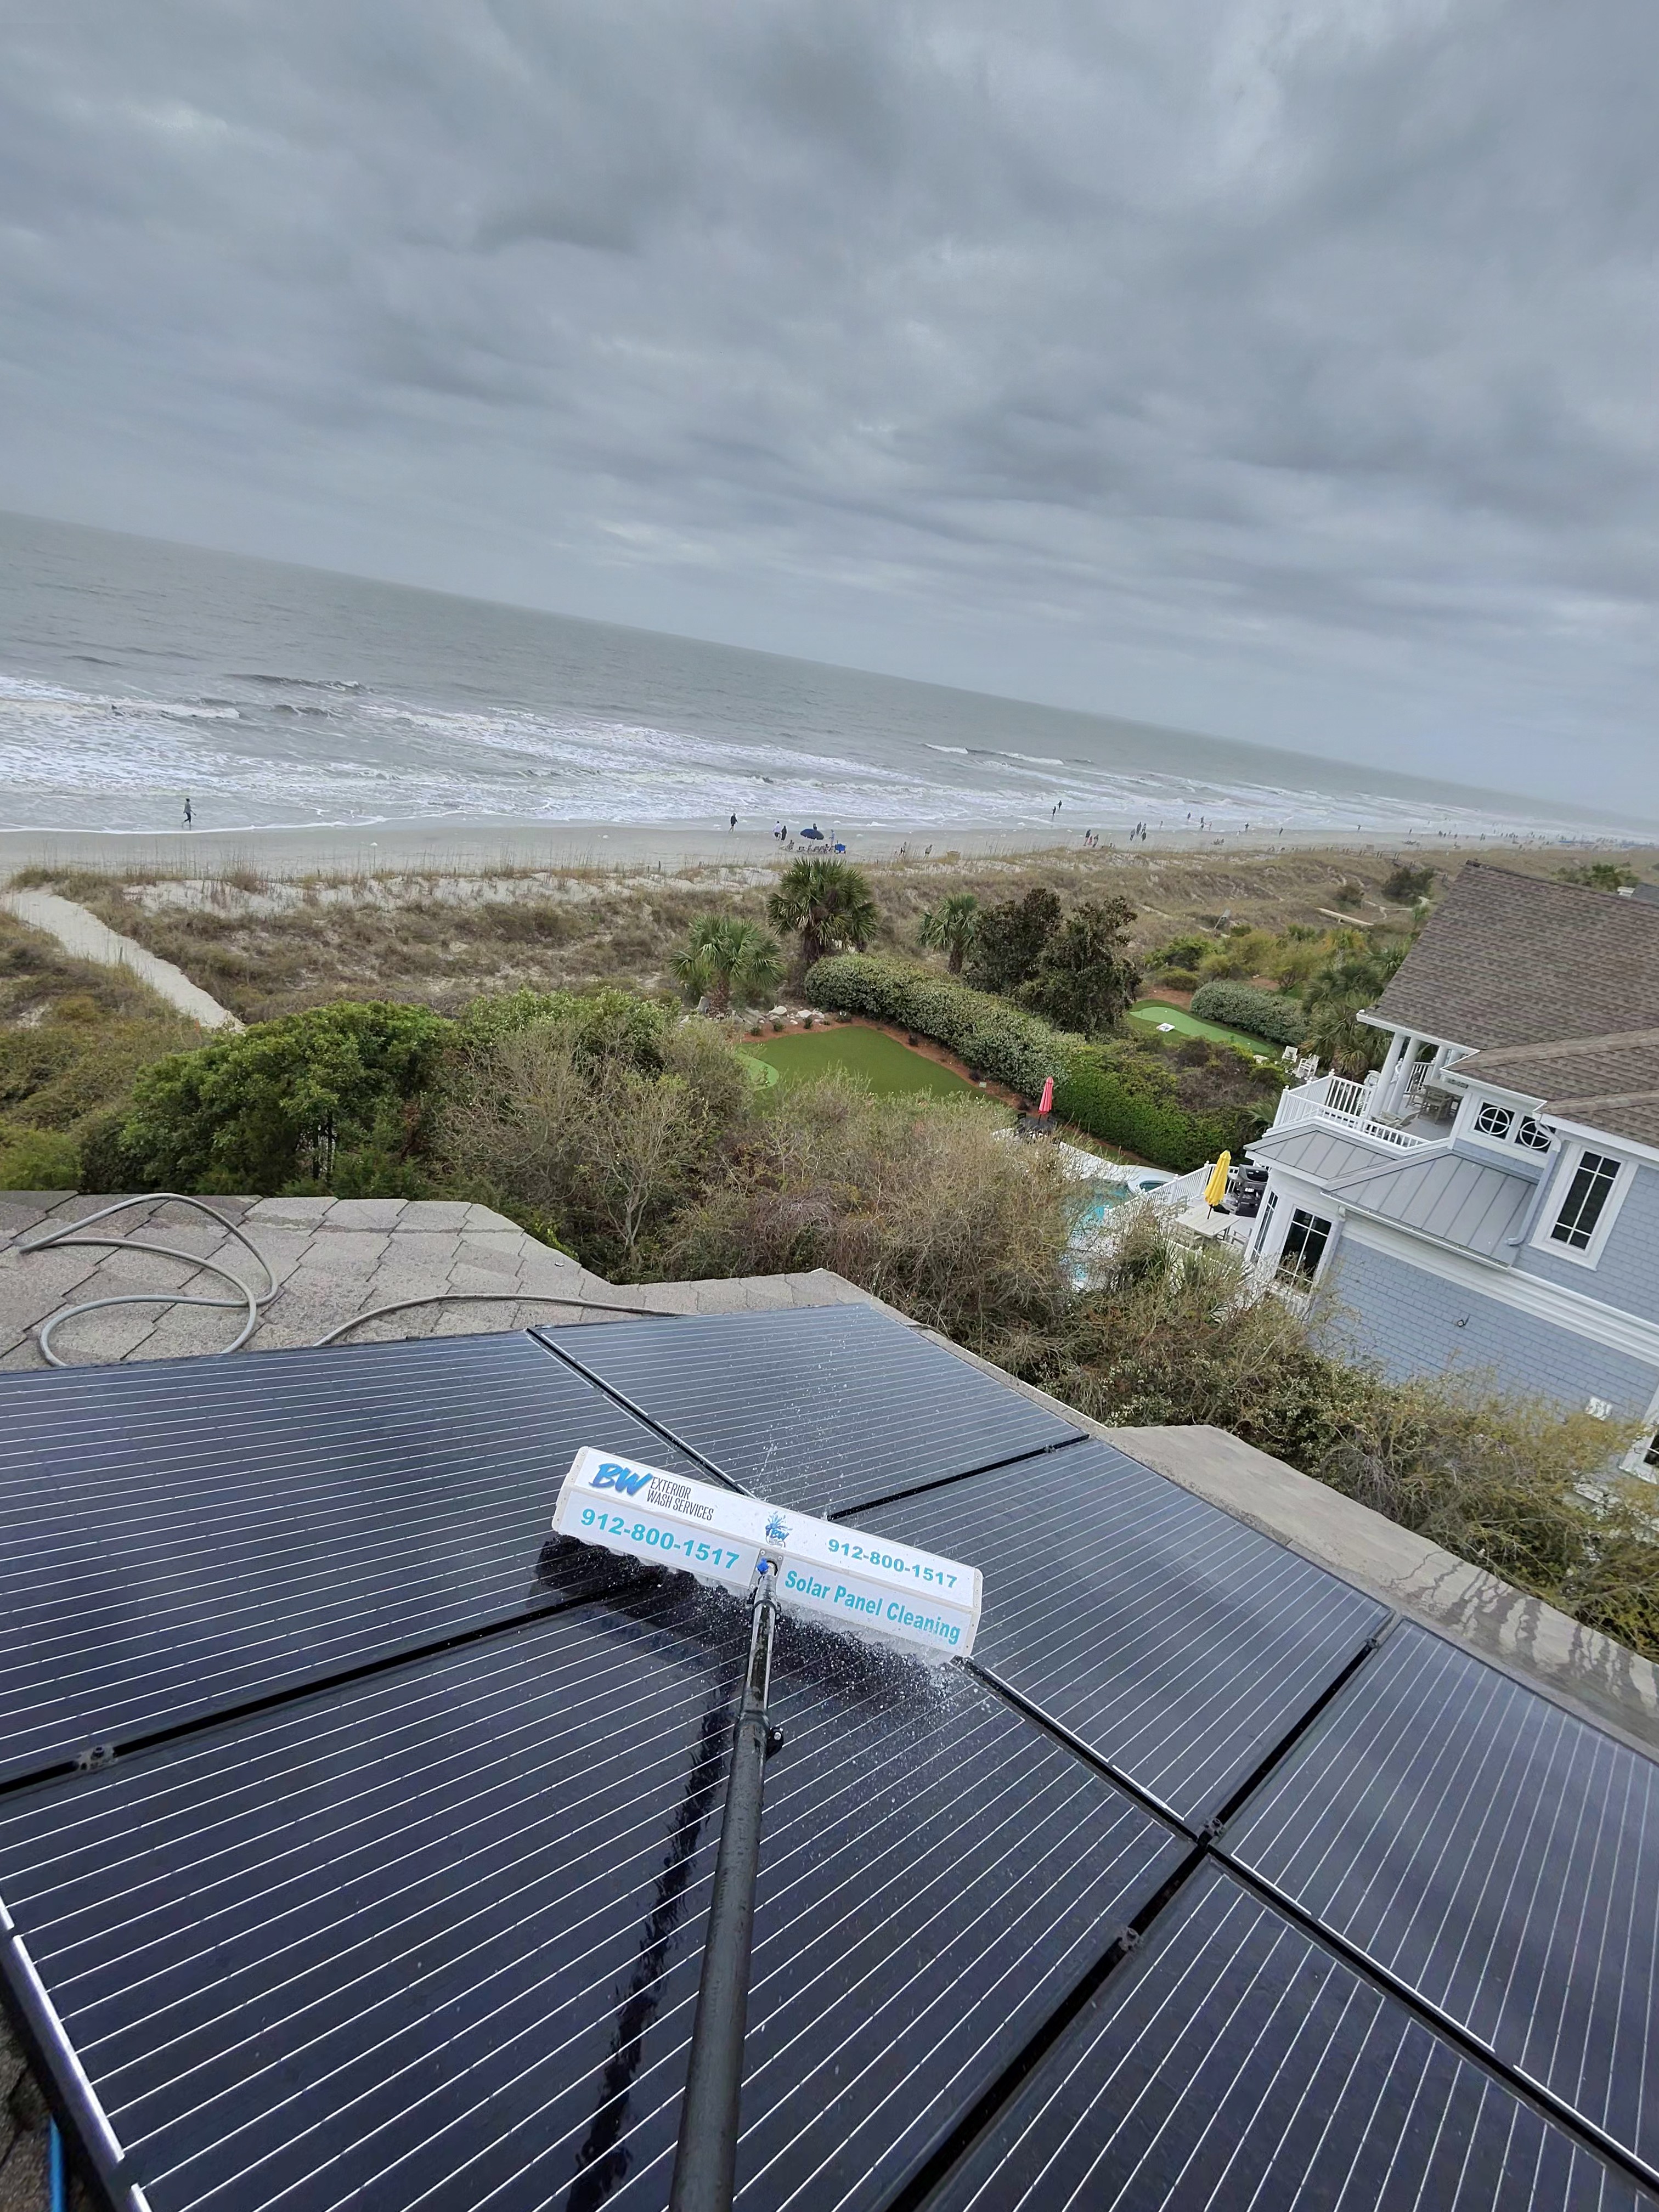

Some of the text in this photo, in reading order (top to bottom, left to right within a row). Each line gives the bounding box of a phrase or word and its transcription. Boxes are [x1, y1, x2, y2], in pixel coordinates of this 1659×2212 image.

[589, 1463, 653, 1497] BW
[650, 1477, 691, 1500] EXTERIOR
[647, 1489, 714, 1521] WASH SERVICES
[581, 1508, 740, 1569] 912-800-1517
[828, 1539, 957, 1588] 912-800-1517
[785, 1570, 961, 1645] Solar Panel Cleaning
